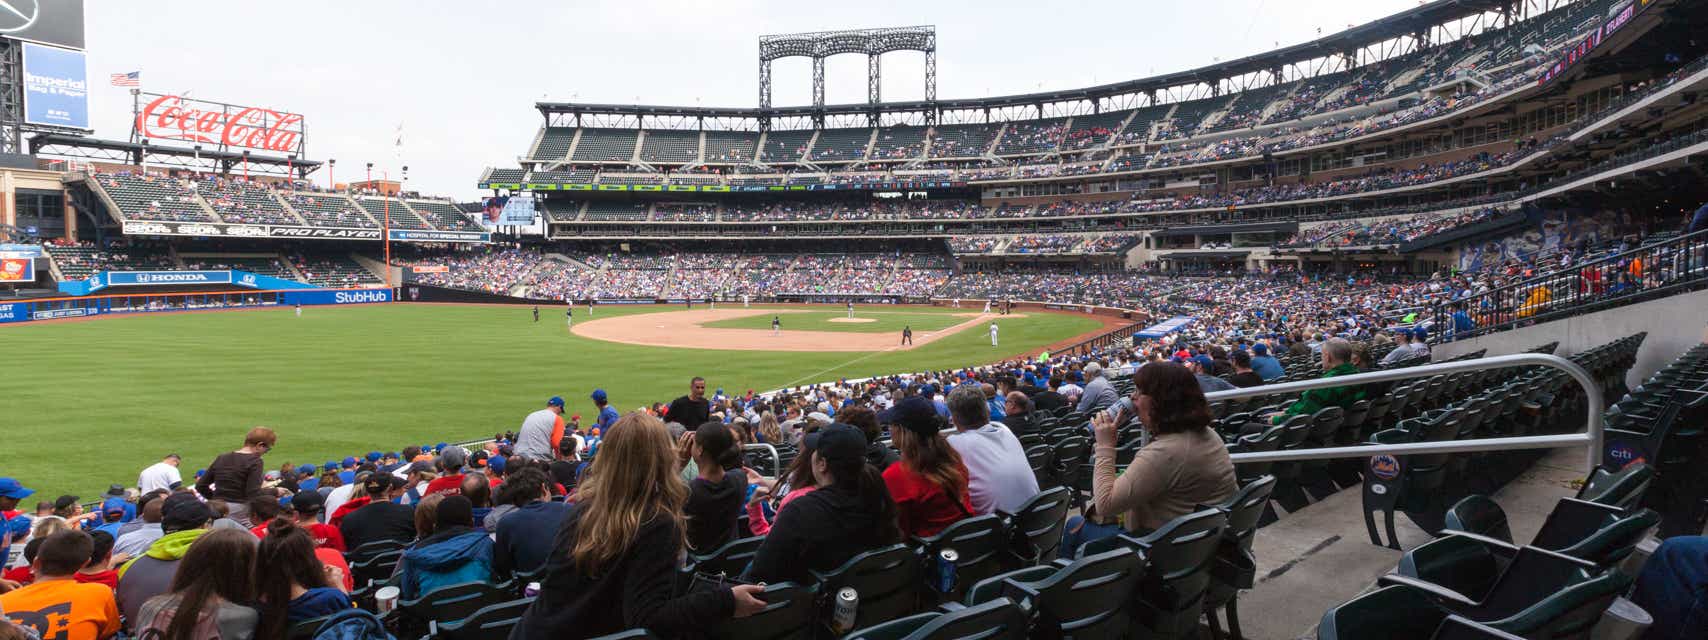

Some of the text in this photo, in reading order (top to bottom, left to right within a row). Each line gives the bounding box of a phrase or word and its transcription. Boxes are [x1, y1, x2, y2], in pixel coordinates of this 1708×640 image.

[26, 72, 85, 90] Imperial
[270, 227, 379, 238] PRO PLAYER
[151, 273, 208, 282] HONDA
[335, 291, 387, 303] StubHub
[1610, 448, 1632, 460] citi
